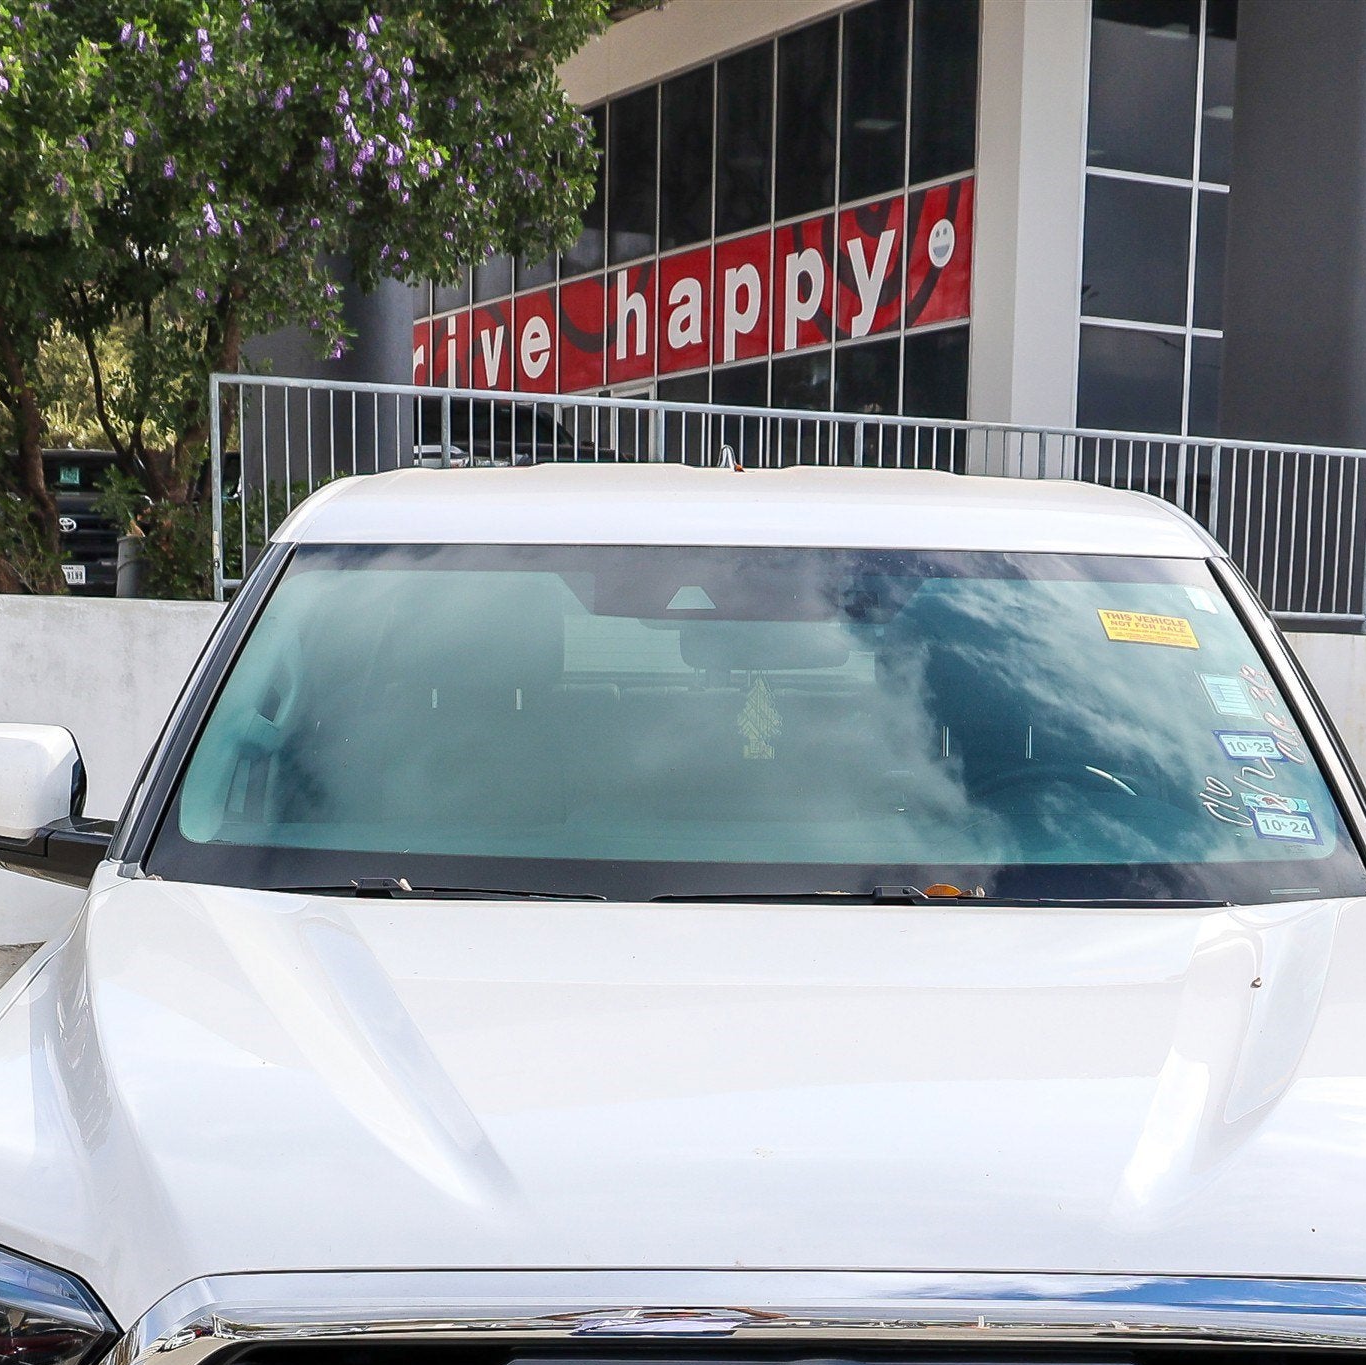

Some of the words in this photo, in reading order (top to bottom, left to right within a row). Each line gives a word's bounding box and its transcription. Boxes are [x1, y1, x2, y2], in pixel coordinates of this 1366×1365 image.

[615, 229, 896, 362] happy
[1104, 612, 1133, 621] THIS
[1134, 615, 1186, 628] VEHICLE
[1110, 620, 1130, 628] NOT
[1135, 622, 1156, 630] FOR
